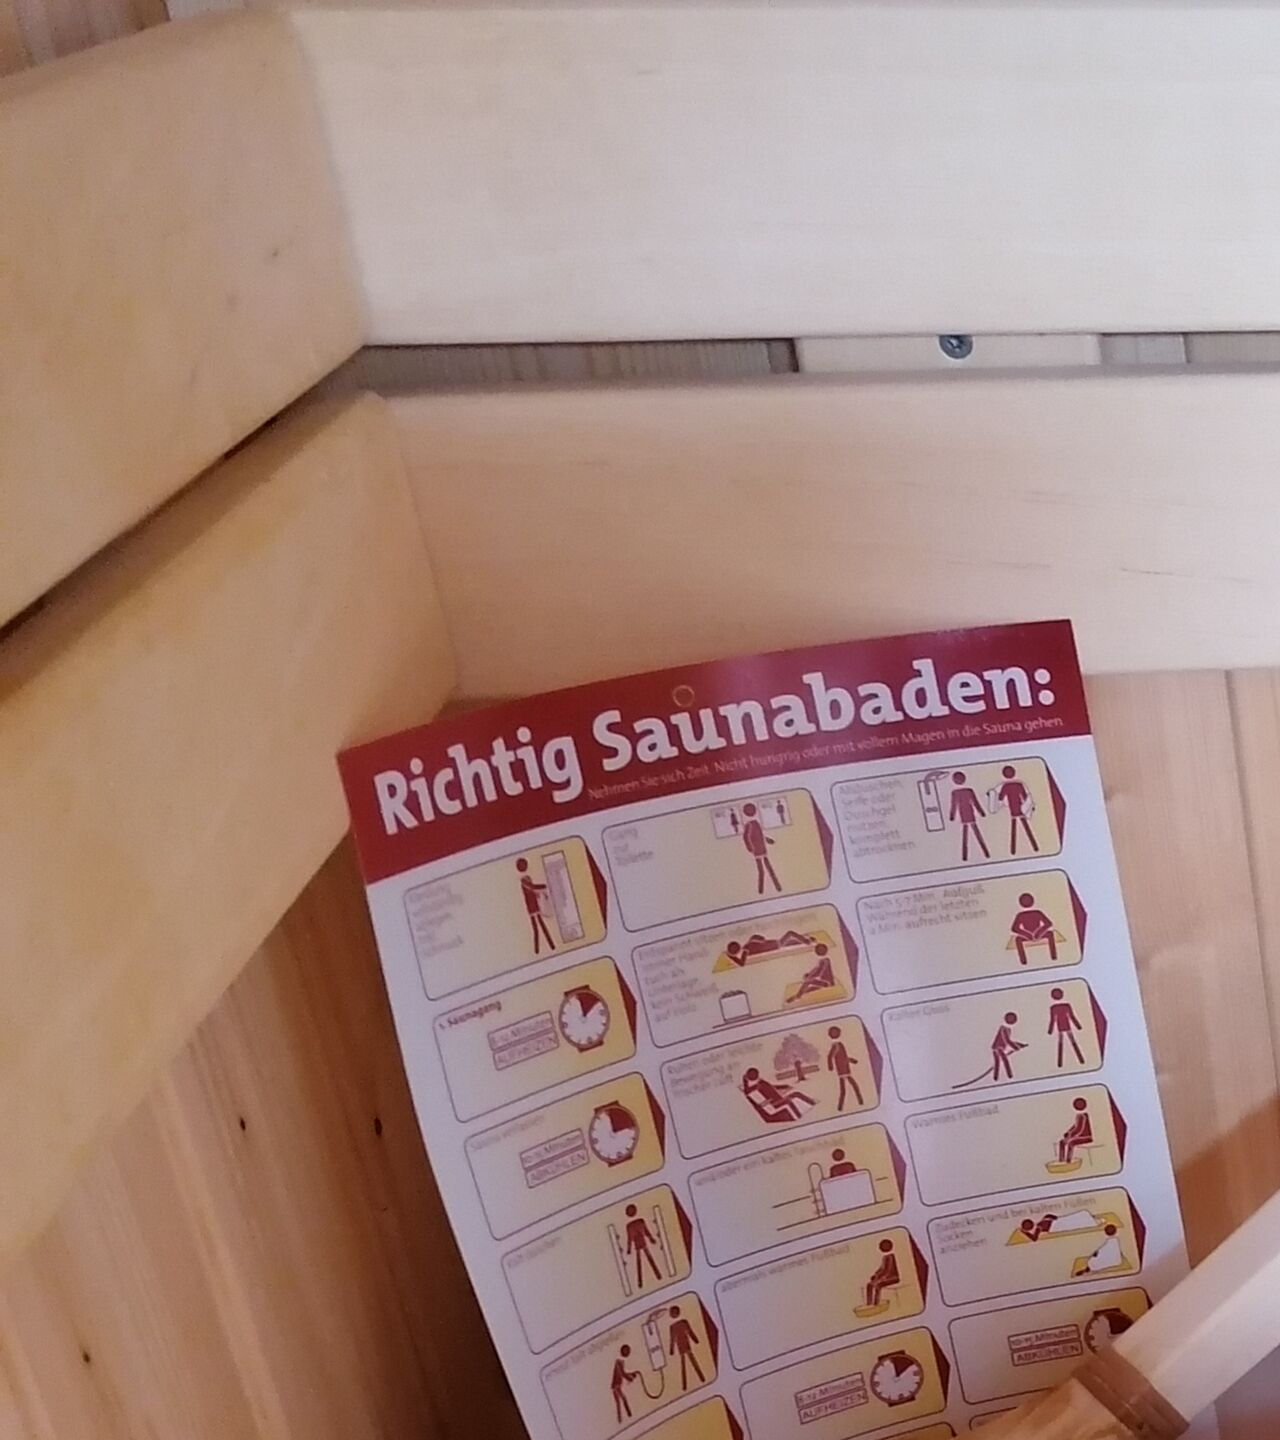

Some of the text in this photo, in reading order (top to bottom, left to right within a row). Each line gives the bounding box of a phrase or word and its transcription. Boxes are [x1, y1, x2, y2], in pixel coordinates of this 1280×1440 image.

[374, 659, 1057, 835] Richtig Saunabaden:
[714, 757, 749, 774] Nicht
[833, 740, 856, 755] mit
[857, 735, 900, 751] vollem
[901, 729, 945, 747] Magen
[950, 727, 961, 739] in
[962, 723, 981, 737] die
[983, 720, 1023, 735] Sauna
